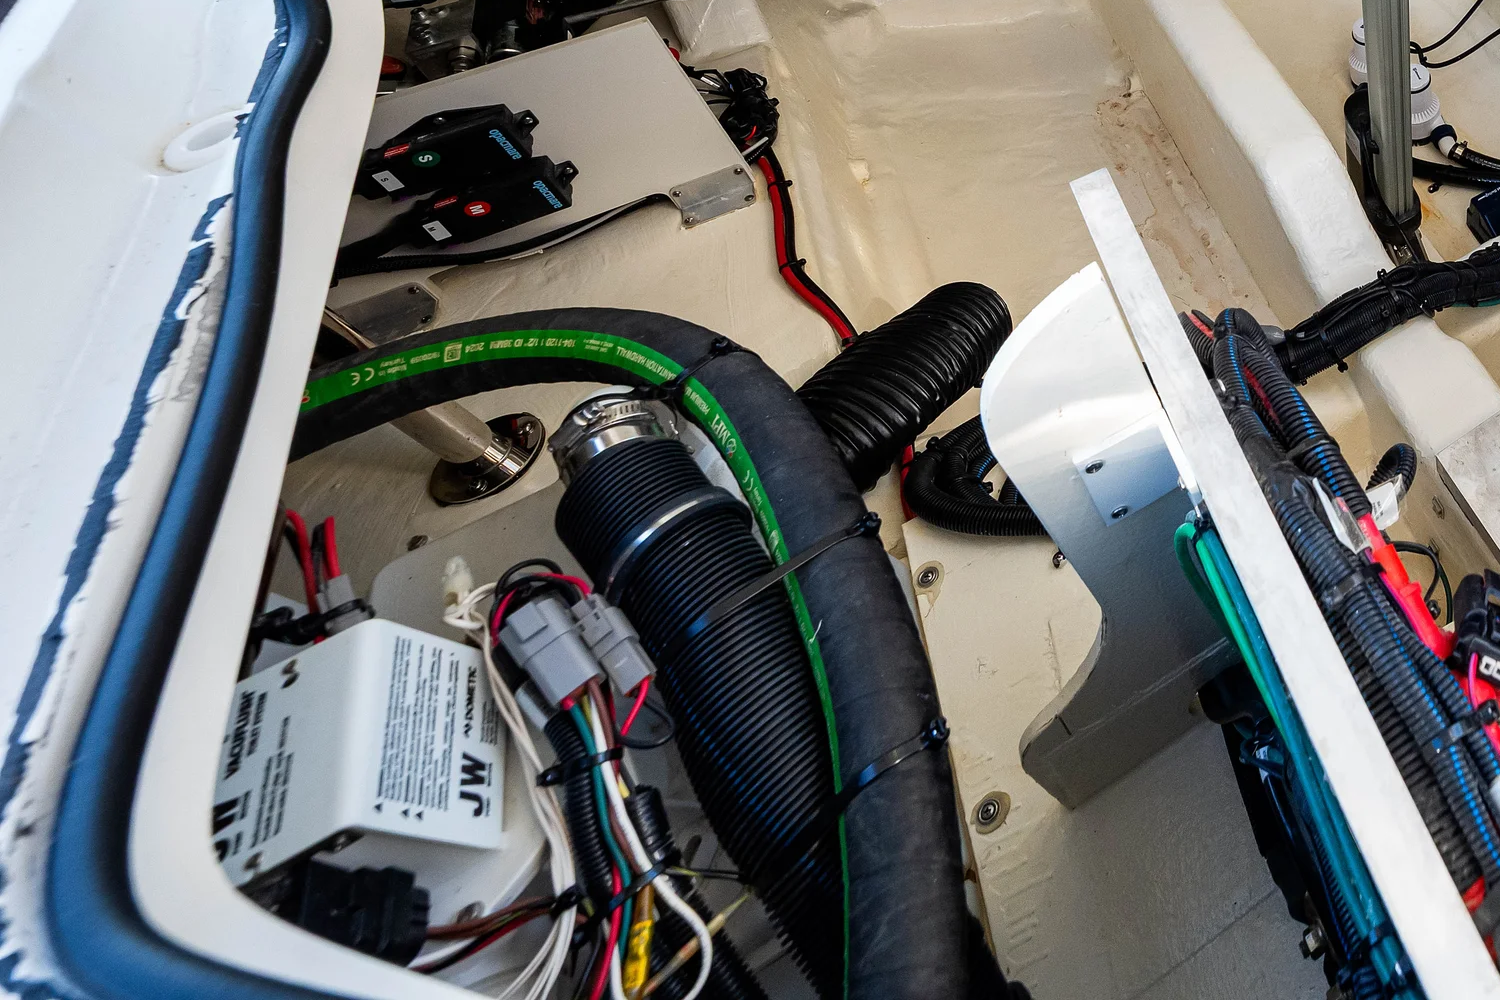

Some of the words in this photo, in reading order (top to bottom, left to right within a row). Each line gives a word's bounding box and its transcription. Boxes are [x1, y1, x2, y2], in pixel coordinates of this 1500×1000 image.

[488, 129, 521, 160] opacmare
[418, 155, 433, 163] S
[533, 180, 562, 209] opacmare
[469, 205, 485, 215] M
[464, 341, 484, 351] 2024
[615, 345, 646, 364] HARDWALL
[379, 357, 404, 367] Turkey
[644, 358, 676, 381] SANITATION
[708, 413, 732, 442] MPI
[463, 666, 477, 720] DOMETIC
[222, 689, 255, 782] VACUFLUSH
[454, 752, 488, 817] JW
